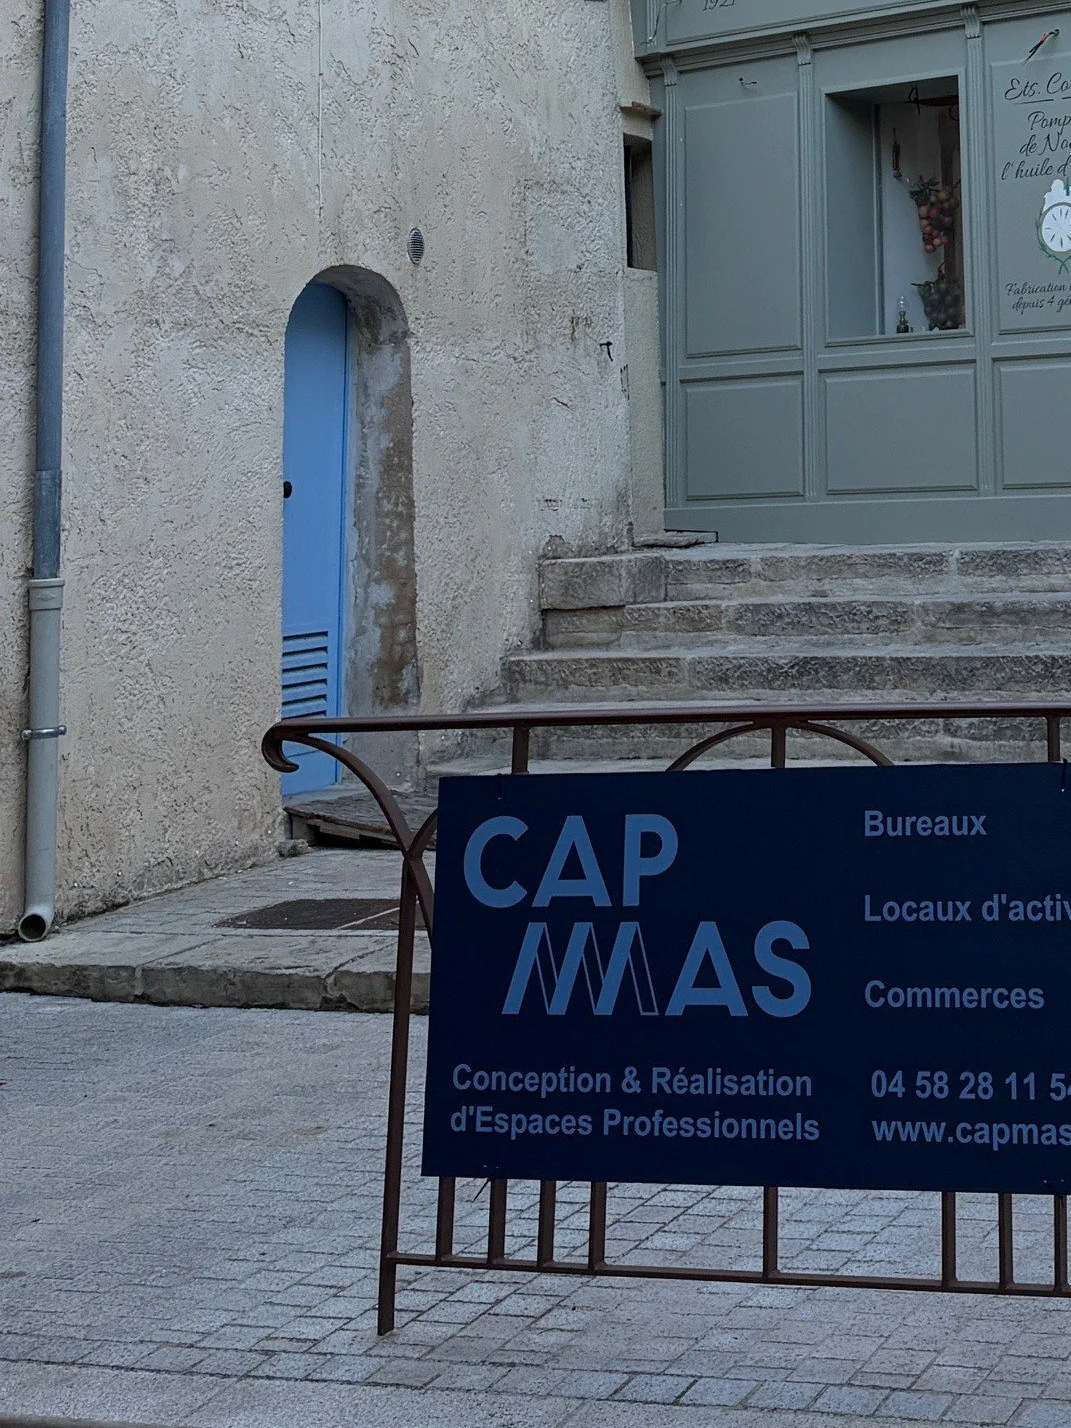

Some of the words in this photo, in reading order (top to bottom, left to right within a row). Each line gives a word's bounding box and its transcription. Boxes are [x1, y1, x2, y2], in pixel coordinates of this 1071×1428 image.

[1004, 77, 1041, 101] Ets.
[1019, 134, 1038, 157] de
[1001, 158, 1053, 181] l'huile
[1005, 281, 1066, 296] Fabrication
[1011, 296, 1046, 315] depuis
[864, 809, 987, 837] Bureaux
[463, 813, 679, 909] CAP
[864, 894, 973, 922] Locaux
[864, 979, 1045, 1009] Commerces
[452, 1063, 612, 1099] Conception
[620, 1066, 642, 1094] &
[651, 1066, 813, 1097] Réalisation
[871, 1069, 906, 1098] 04
[915, 1070, 949, 1099] 58
[959, 1071, 994, 1100] 28
[1004, 1071, 1037, 1101] 11
[450, 1105, 593, 1141] d'Espaces
[603, 1108, 821, 1141] Professionnels
